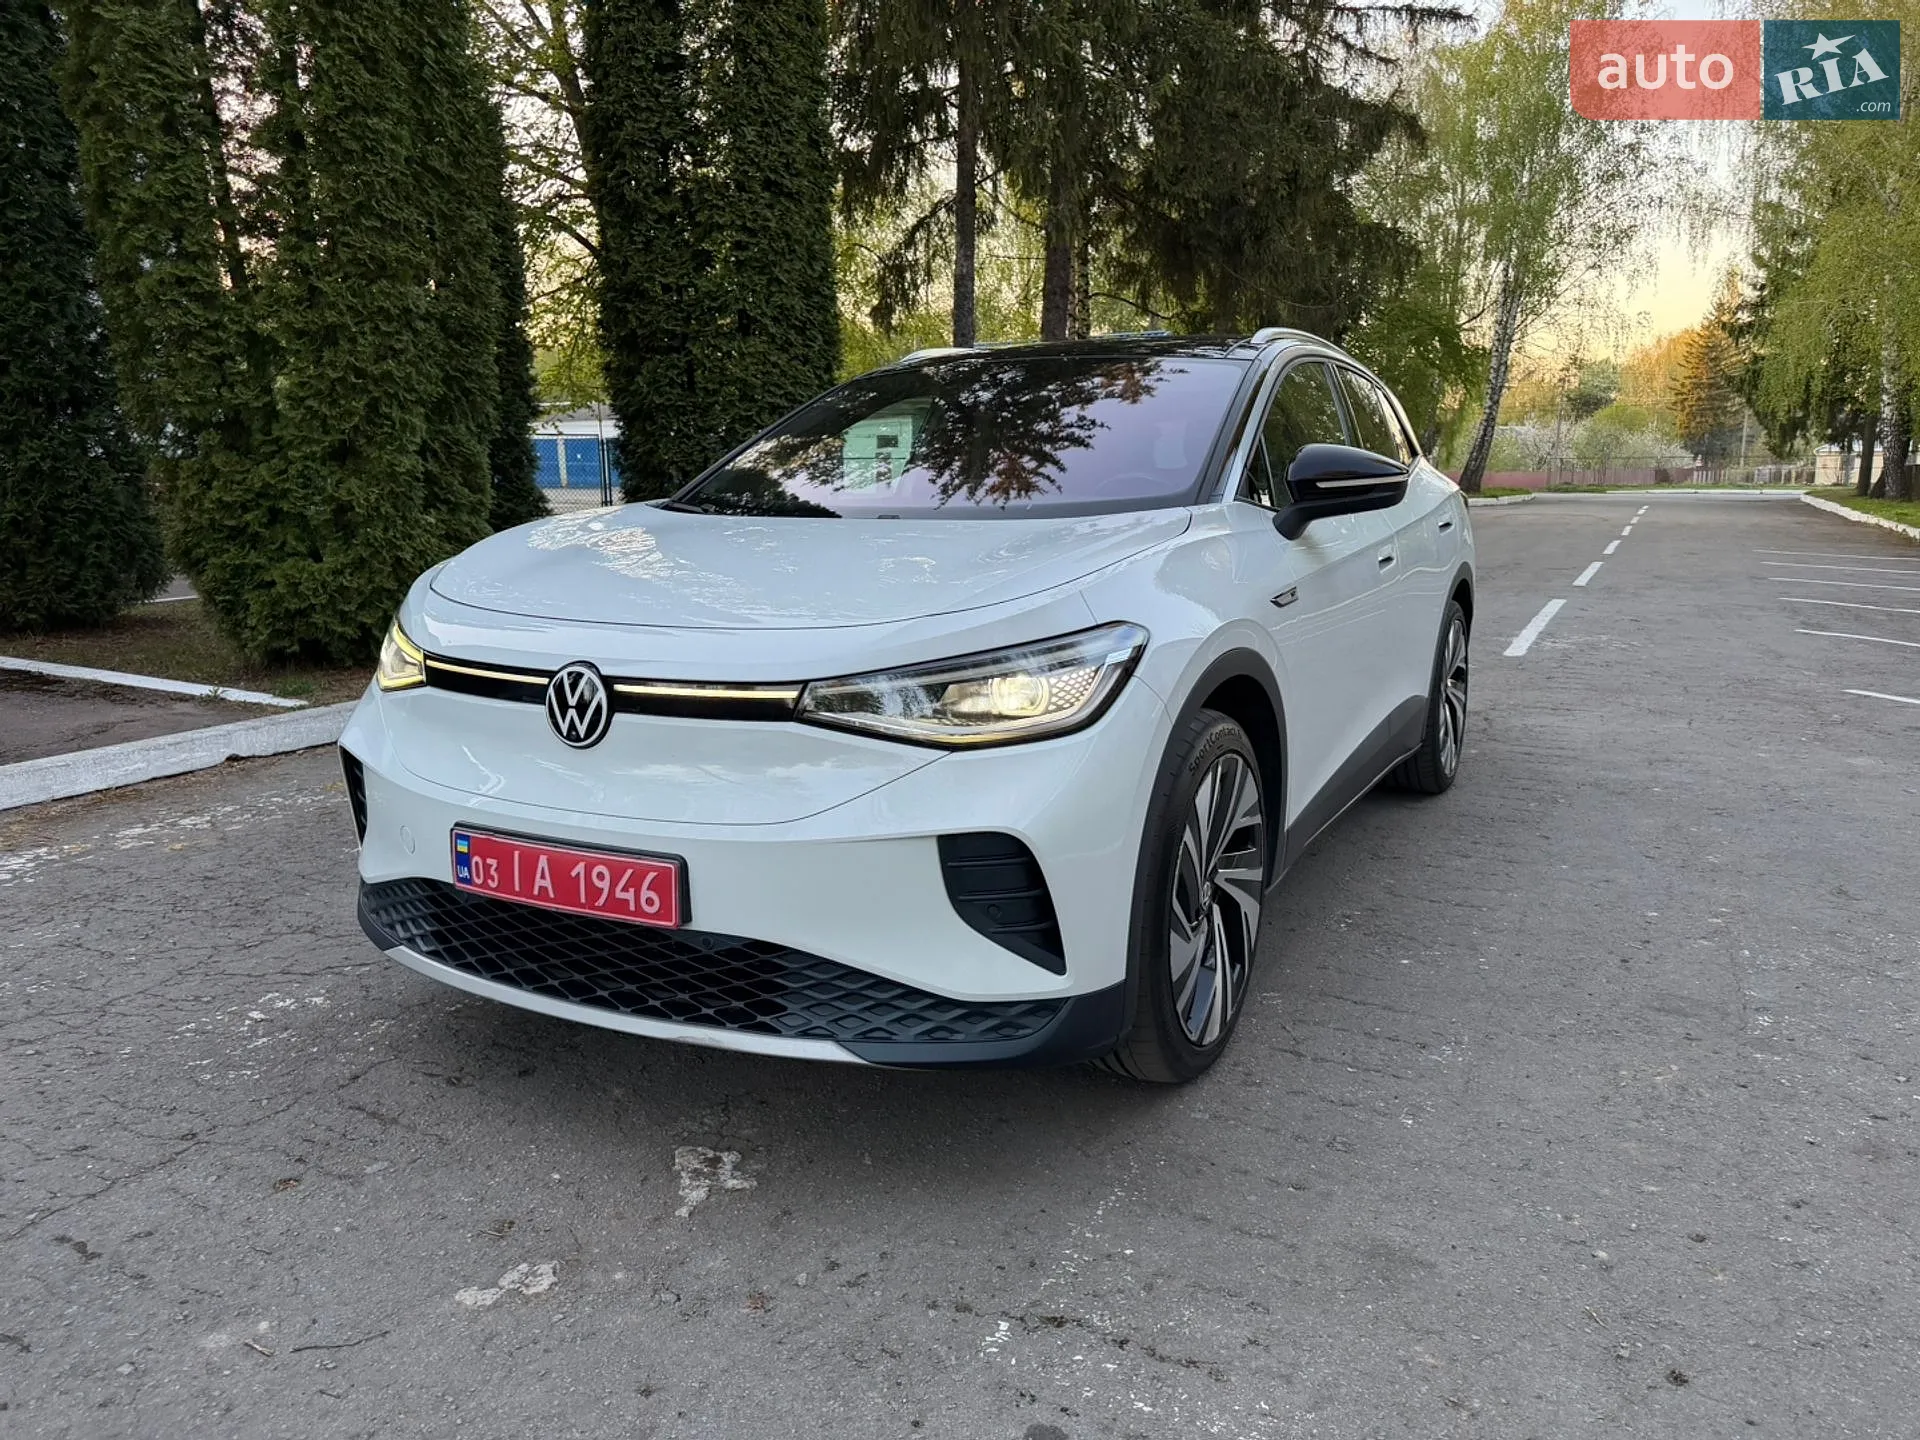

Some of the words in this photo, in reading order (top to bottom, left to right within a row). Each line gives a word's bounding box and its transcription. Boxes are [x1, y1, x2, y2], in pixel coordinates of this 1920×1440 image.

[457, 865, 470, 879] UA
[471, 855, 499, 888] 03
[570, 861, 660, 914] 1946
